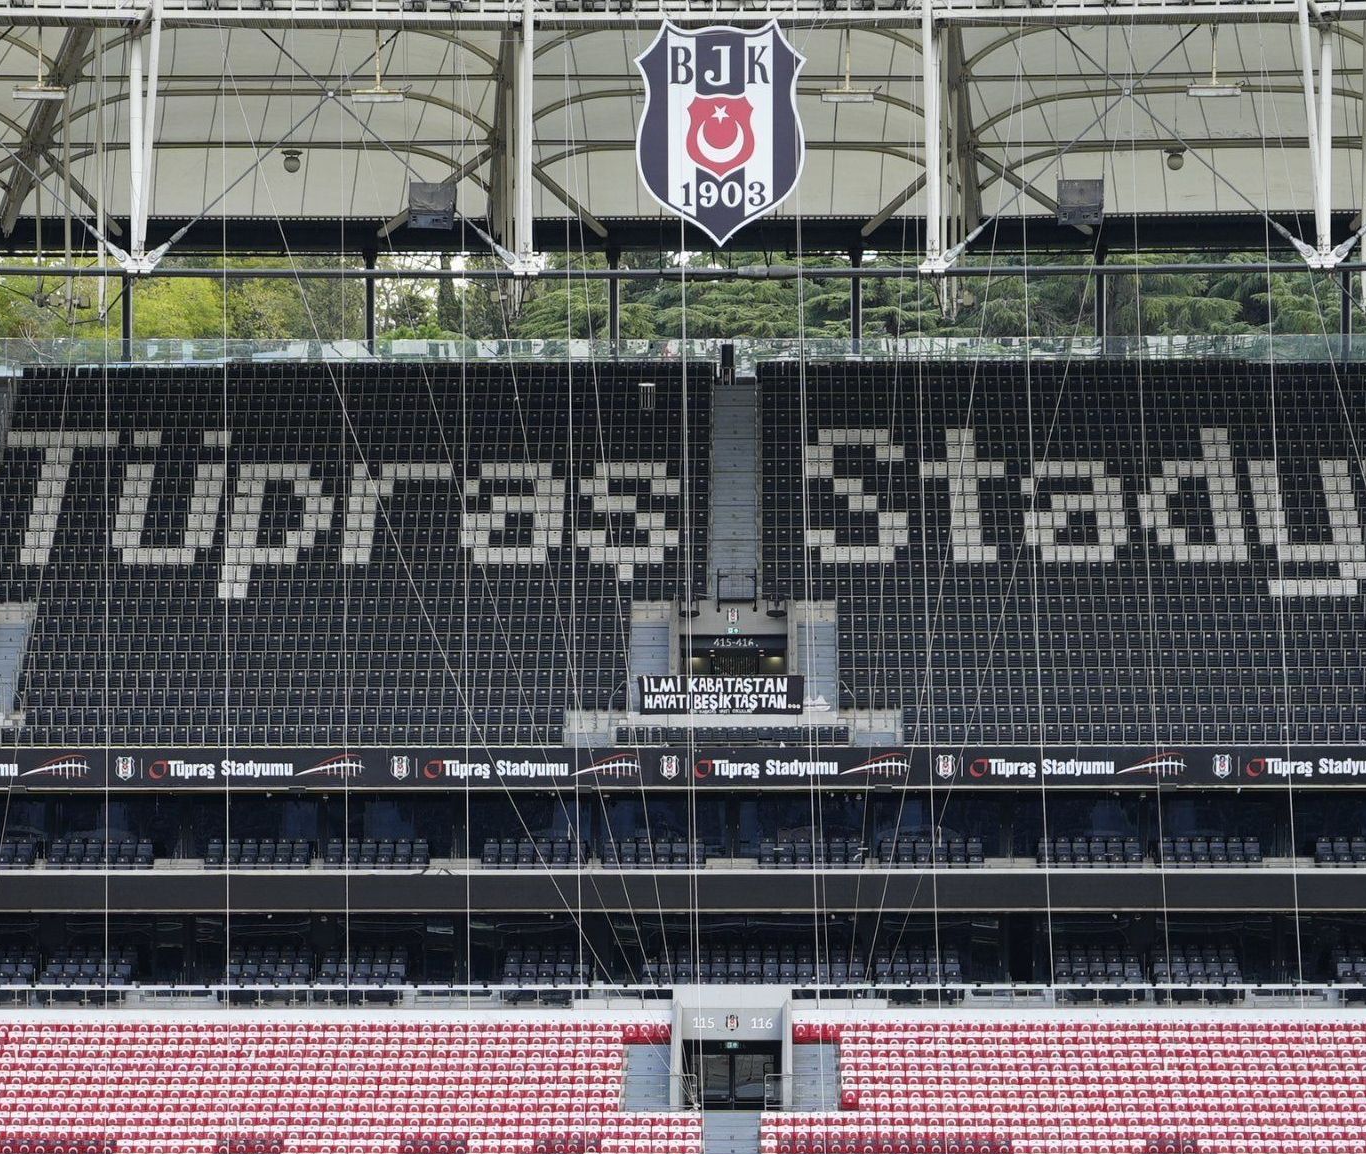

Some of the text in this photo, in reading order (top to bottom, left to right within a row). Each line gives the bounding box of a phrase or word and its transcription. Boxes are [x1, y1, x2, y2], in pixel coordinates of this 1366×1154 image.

[669, 45, 771, 86] BJK
[680, 181, 766, 208] 1903
[7, 431, 680, 598] Tüpraş
[167, 760, 294, 779] Tüpraş Stadyumu
[442, 760, 569, 779] Tüpraş Stadyumu
[712, 759, 839, 778] Tüpraş Stadyumu
[988, 758, 1115, 777] Tüpraş Stadyumu
[1264, 758, 1313, 777] Tüpraş
[692, 1017, 715, 1029] 115
[751, 1017, 773, 1029] 116
